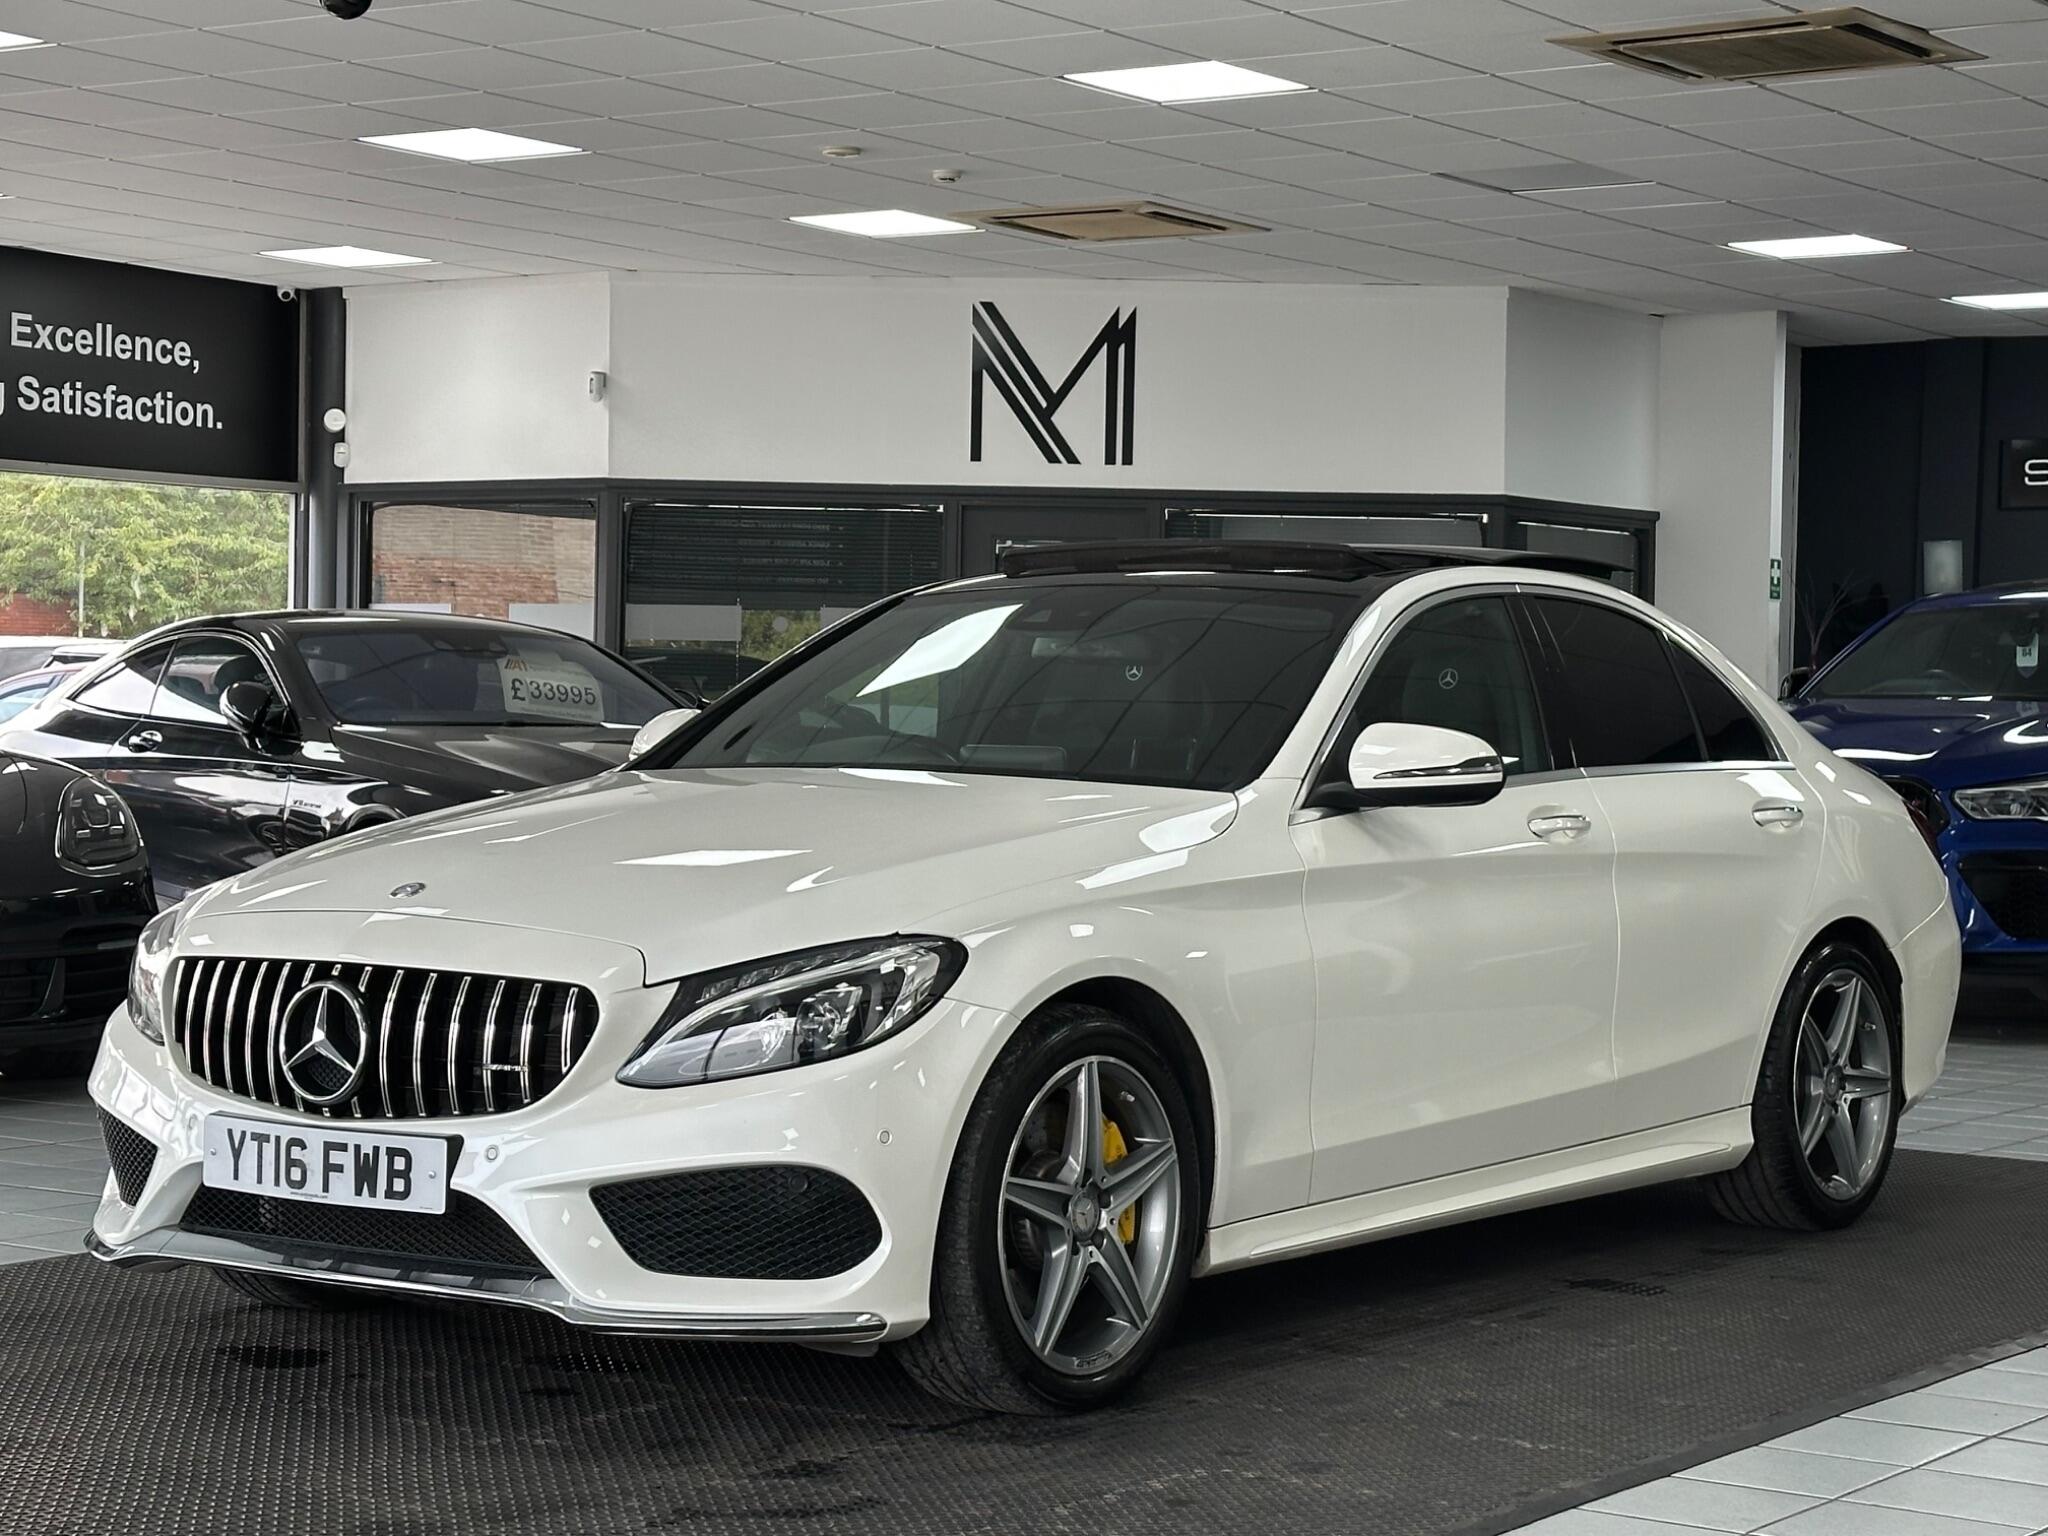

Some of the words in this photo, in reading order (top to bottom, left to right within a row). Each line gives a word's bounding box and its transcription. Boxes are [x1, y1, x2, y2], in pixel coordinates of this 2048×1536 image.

[10, 311, 200, 374] Excellence,
[17, 375, 223, 430] Satisfaction.
[511, 678, 596, 706] £33995
[227, 1128, 308, 1190] YT16
[322, 1140, 413, 1201] FWB
